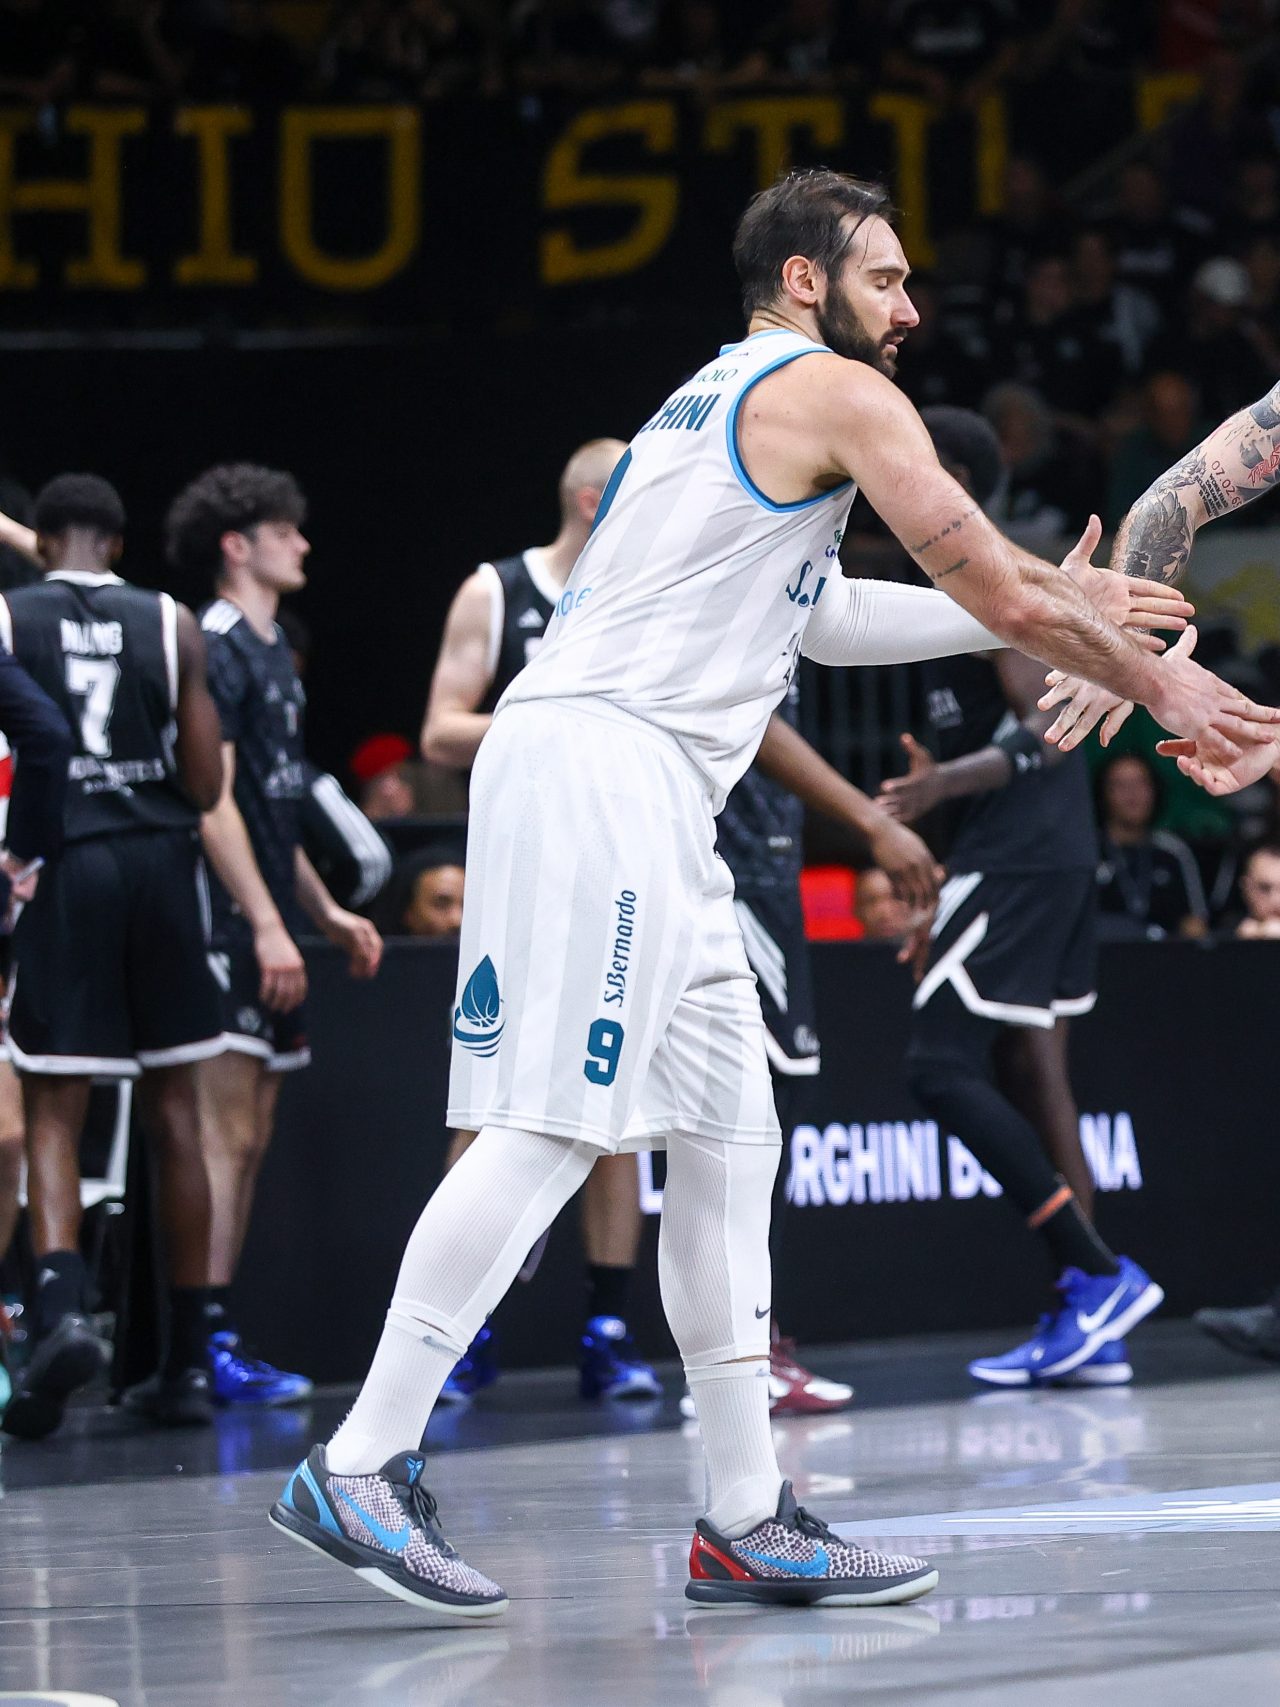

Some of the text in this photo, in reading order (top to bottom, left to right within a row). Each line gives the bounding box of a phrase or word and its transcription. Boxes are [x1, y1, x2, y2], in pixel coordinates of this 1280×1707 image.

[65, 654, 122, 758] 7
[602, 889, 638, 1008] S.Bernardo
[584, 1017, 625, 1087] 9
[638, 1119, 942, 1216] LRGHINI
